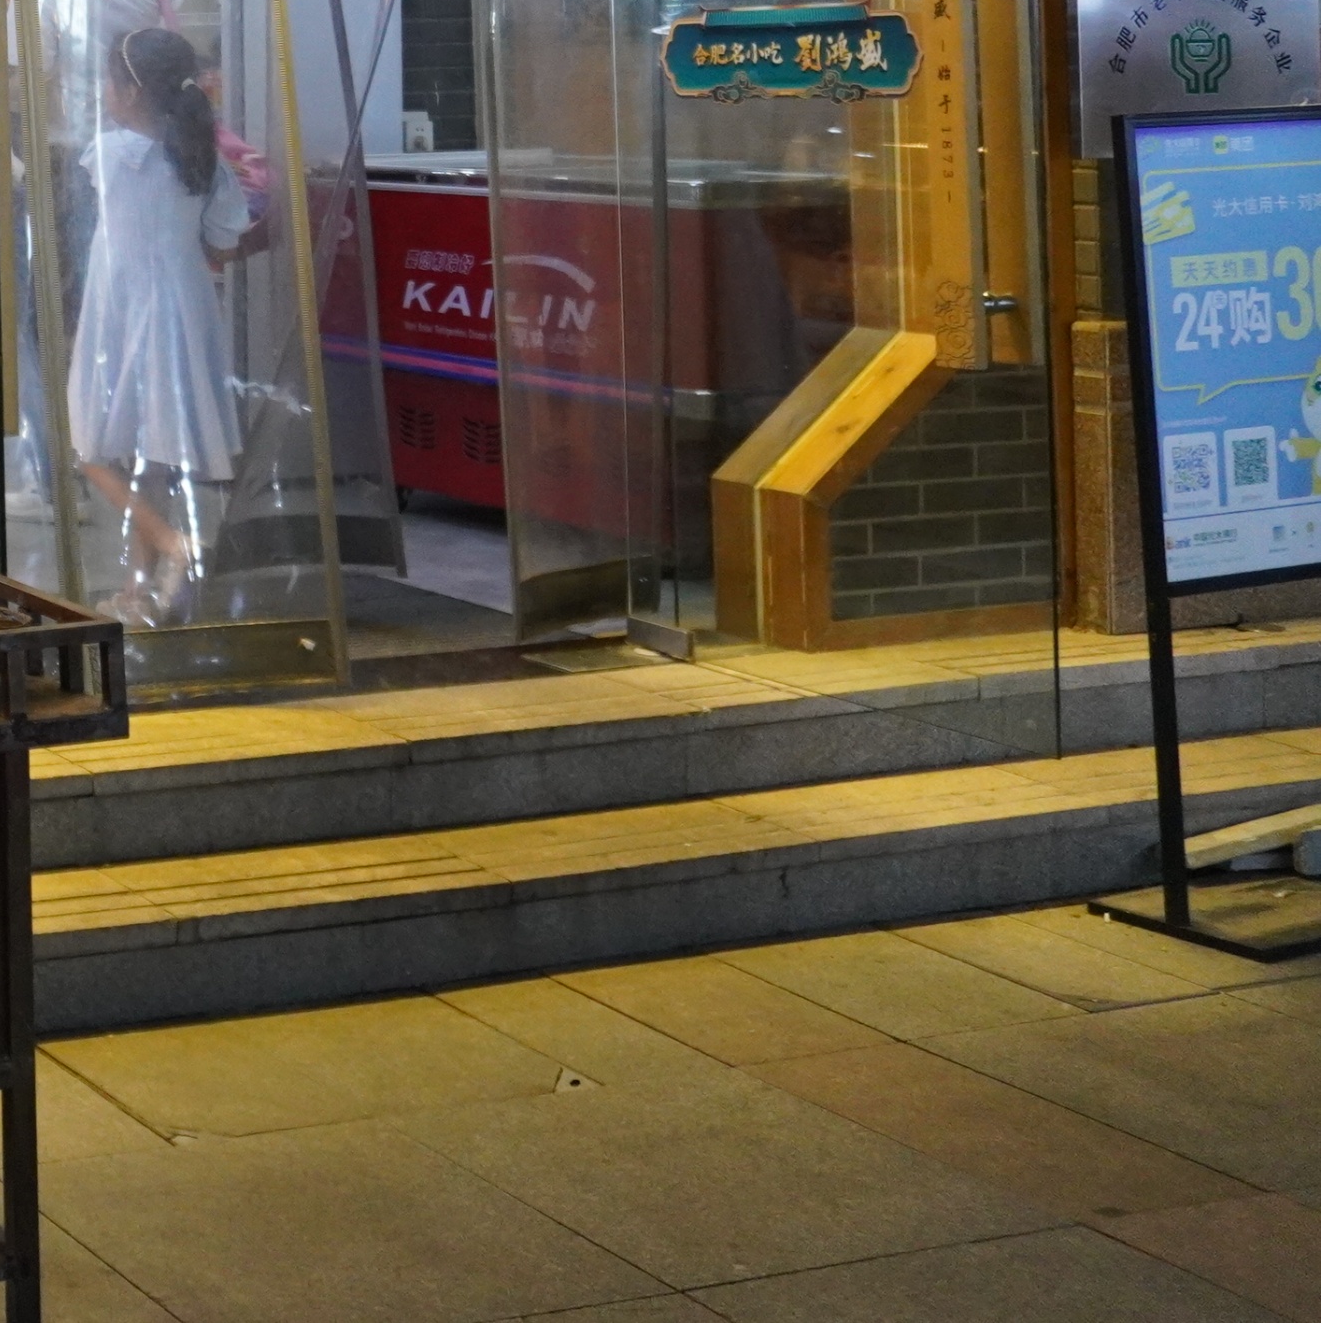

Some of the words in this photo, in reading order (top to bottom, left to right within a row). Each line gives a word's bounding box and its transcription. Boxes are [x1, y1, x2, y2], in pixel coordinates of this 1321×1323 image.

[693, 41, 784, 66] 合肥名小吃
[402, 280, 596, 332] KAILIN
